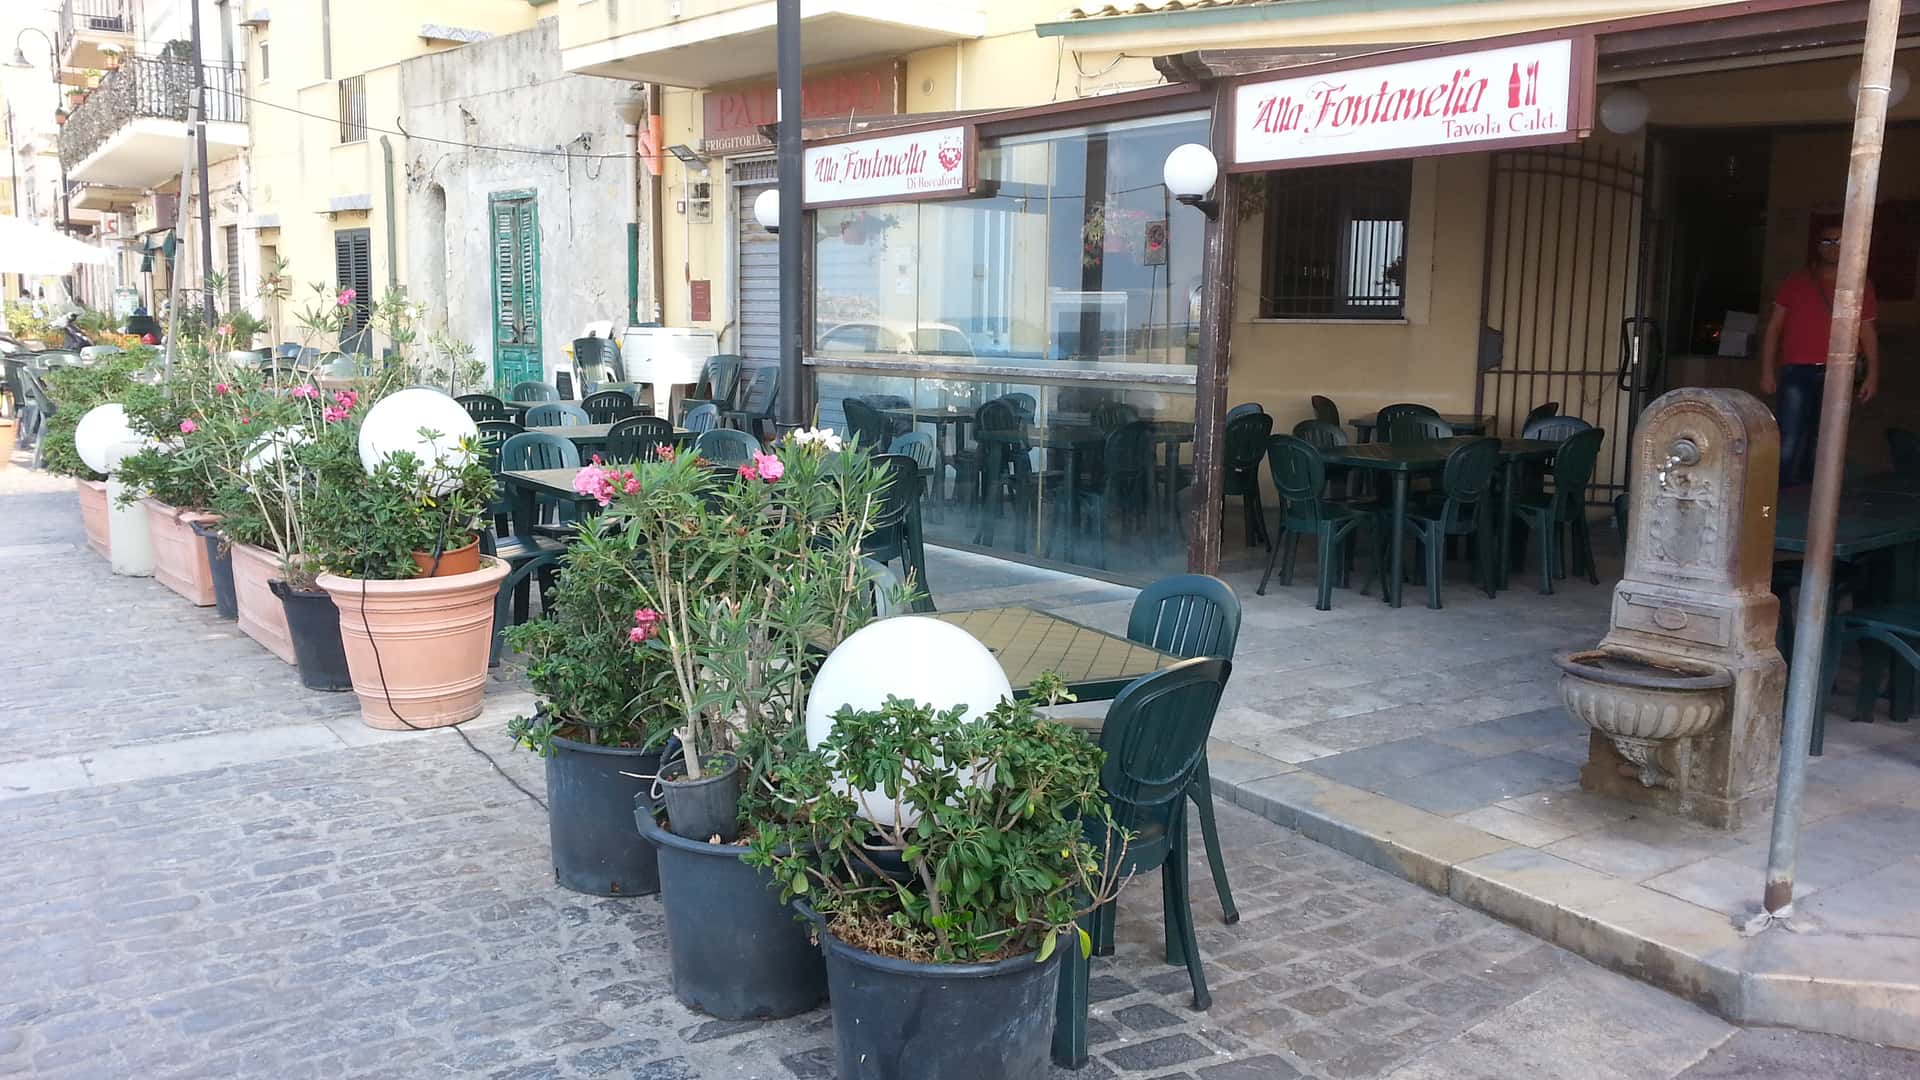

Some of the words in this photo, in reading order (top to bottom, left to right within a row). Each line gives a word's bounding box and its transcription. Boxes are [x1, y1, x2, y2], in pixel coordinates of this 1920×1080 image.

[1253, 94, 1304, 134] Alla
[1442, 113, 1501, 139] Tavola
[1509, 108, 1559, 133] Cald
[705, 134, 761, 152] FRIGGITORIA
[815, 155, 838, 183] Alla
[839, 143, 927, 184] Fontanella
